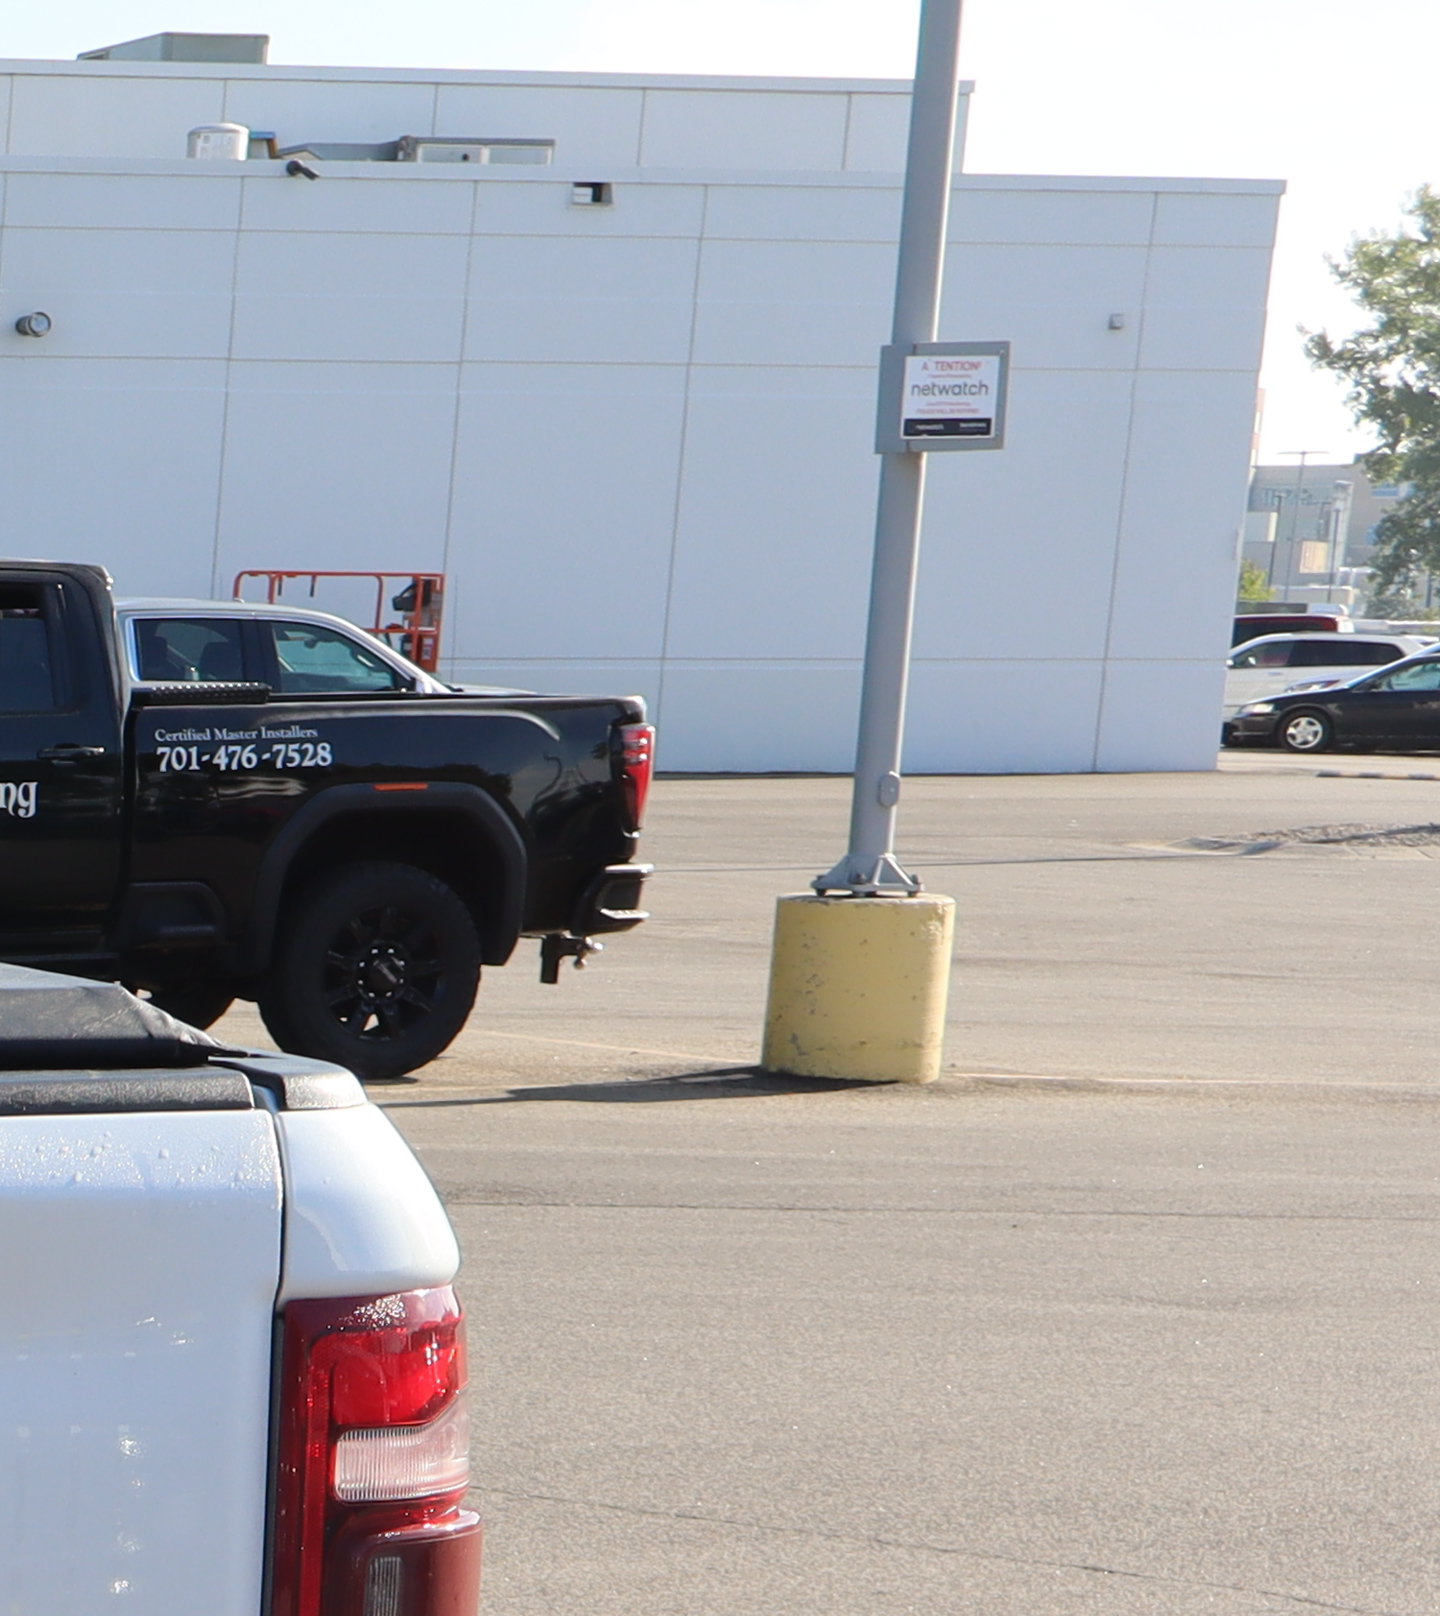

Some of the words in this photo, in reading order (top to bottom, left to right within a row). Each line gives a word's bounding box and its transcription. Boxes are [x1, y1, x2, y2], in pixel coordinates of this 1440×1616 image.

[911, 380, 989, 396] netwatch
[154, 728, 211, 742] Certified
[213, 727, 258, 741] Master
[261, 725, 319, 740] Installers
[156, 742, 333, 772] 701-476-7528
